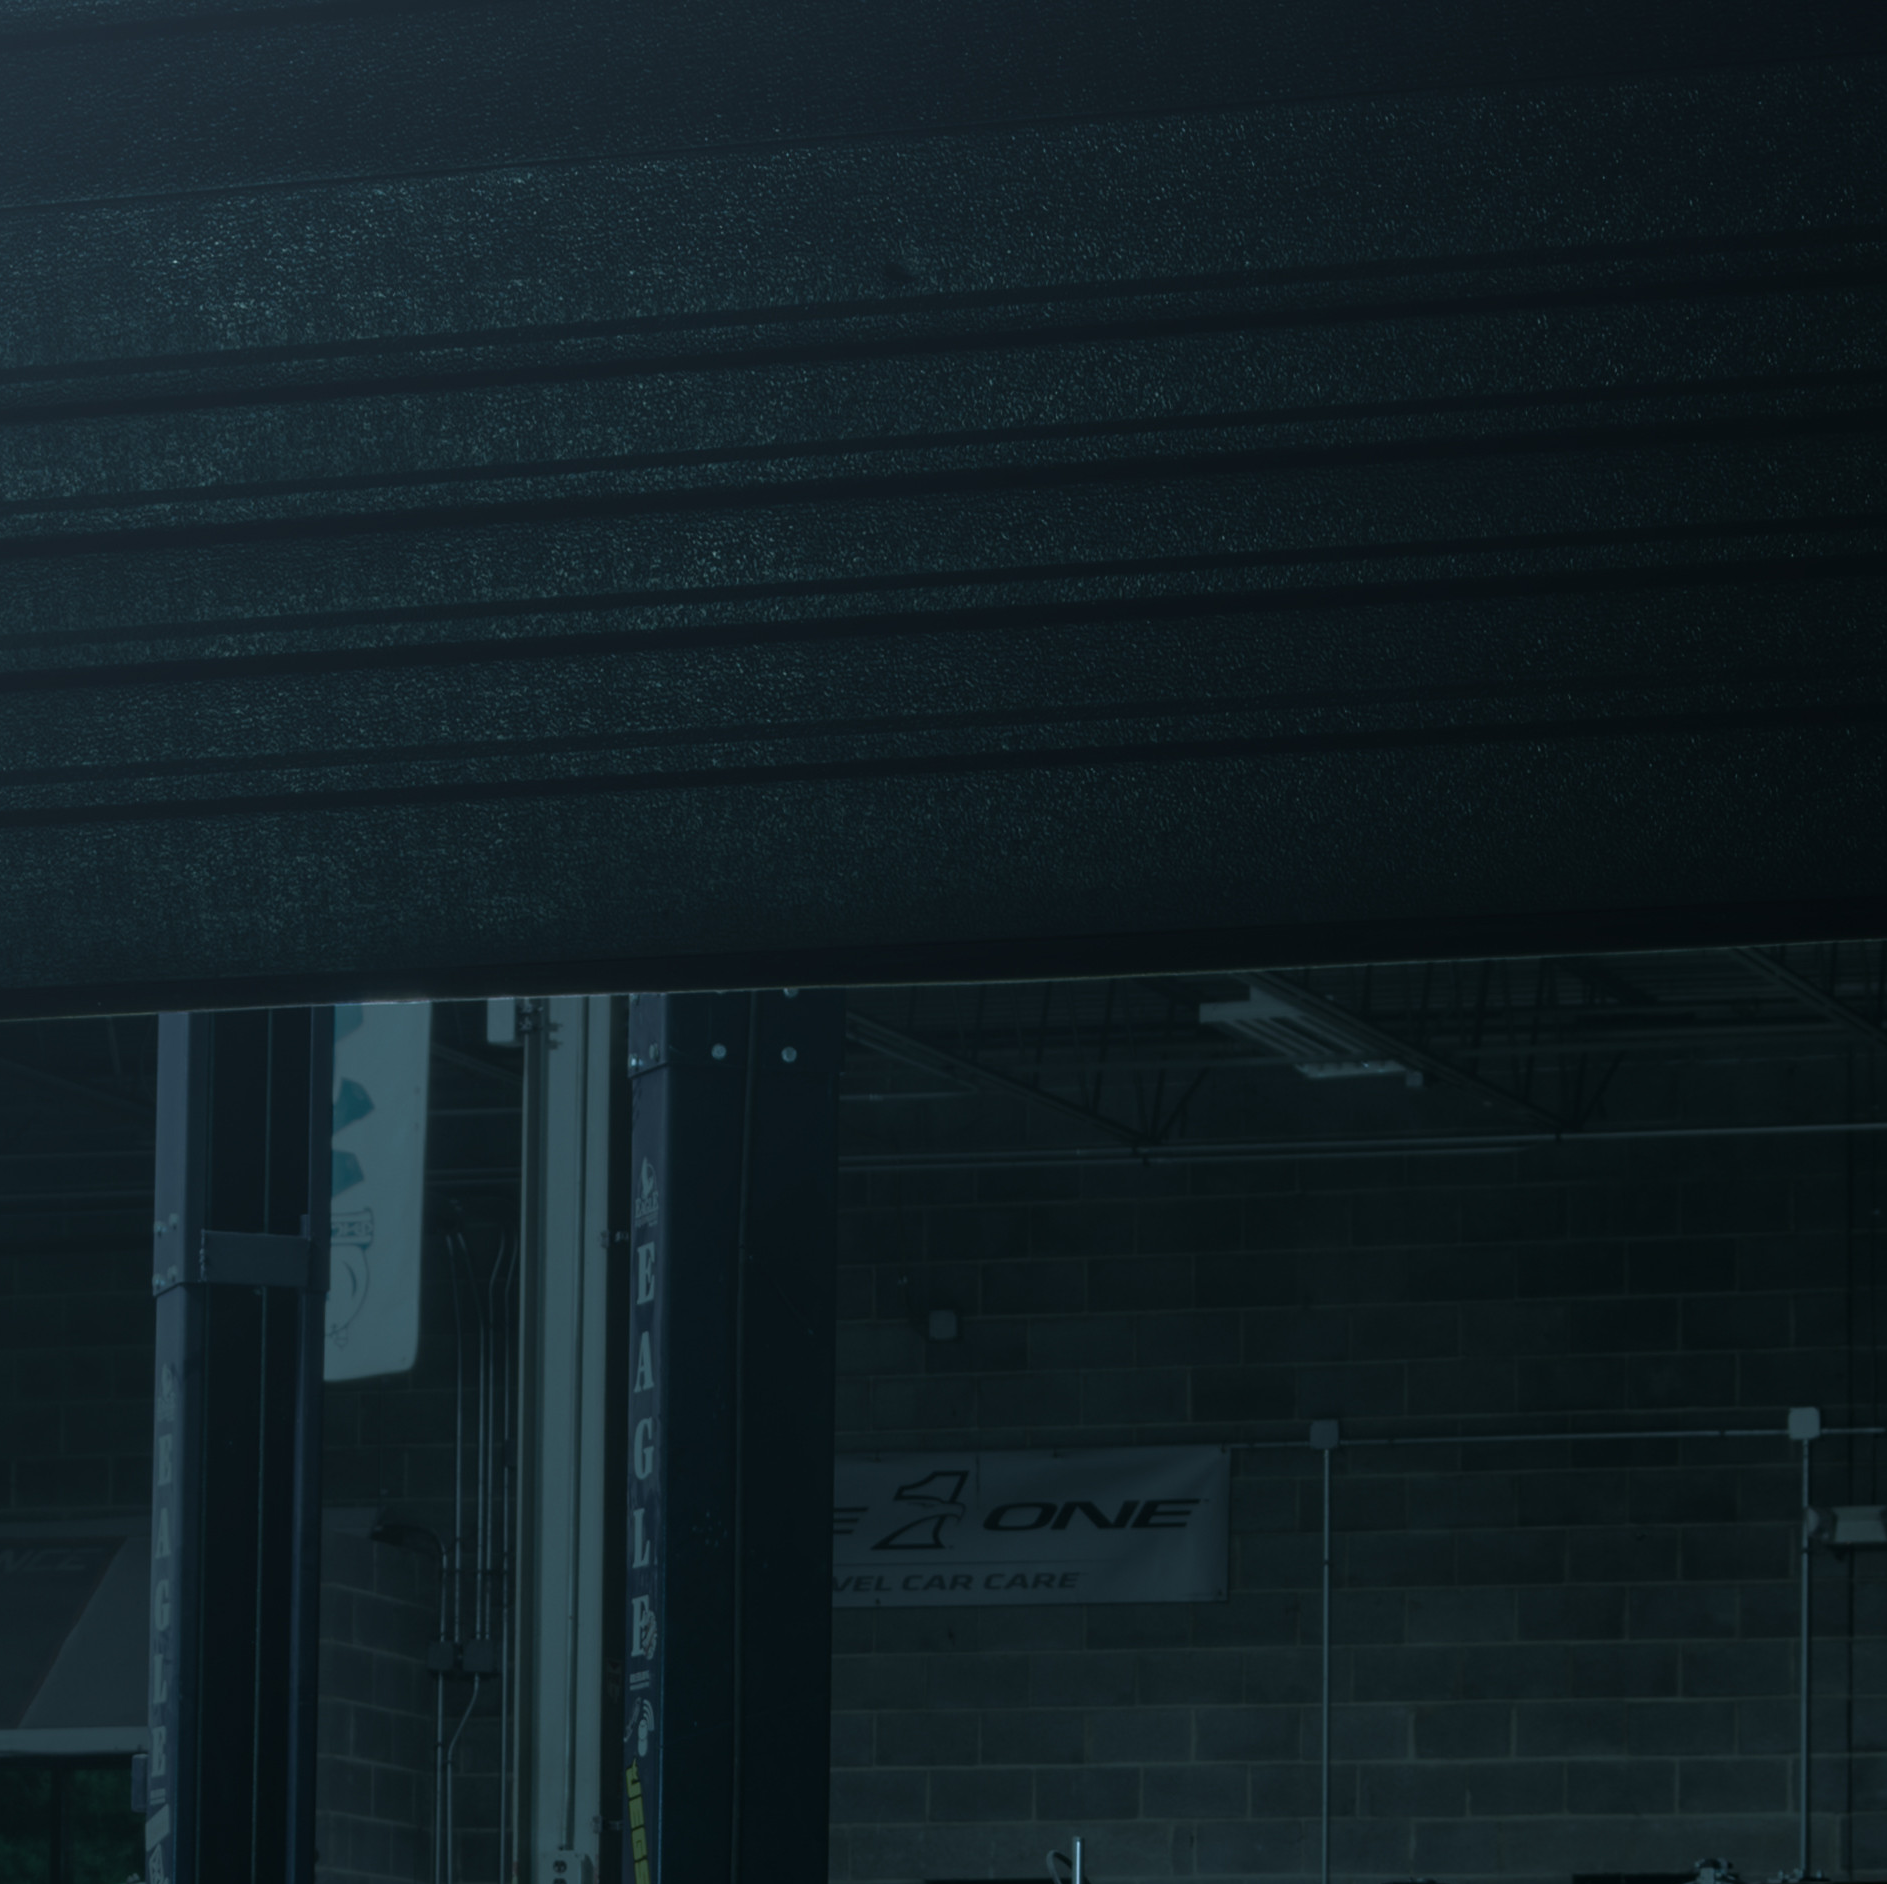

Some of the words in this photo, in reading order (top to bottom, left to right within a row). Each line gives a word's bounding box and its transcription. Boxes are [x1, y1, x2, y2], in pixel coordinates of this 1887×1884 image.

[631, 1241, 656, 1658] EAGLE
[983, 1499, 1201, 1531] ONE
[151, 1433, 172, 1778] EAGLE
[901, 1574, 974, 1591] CAR
[983, 1572, 1080, 1589] CARE
